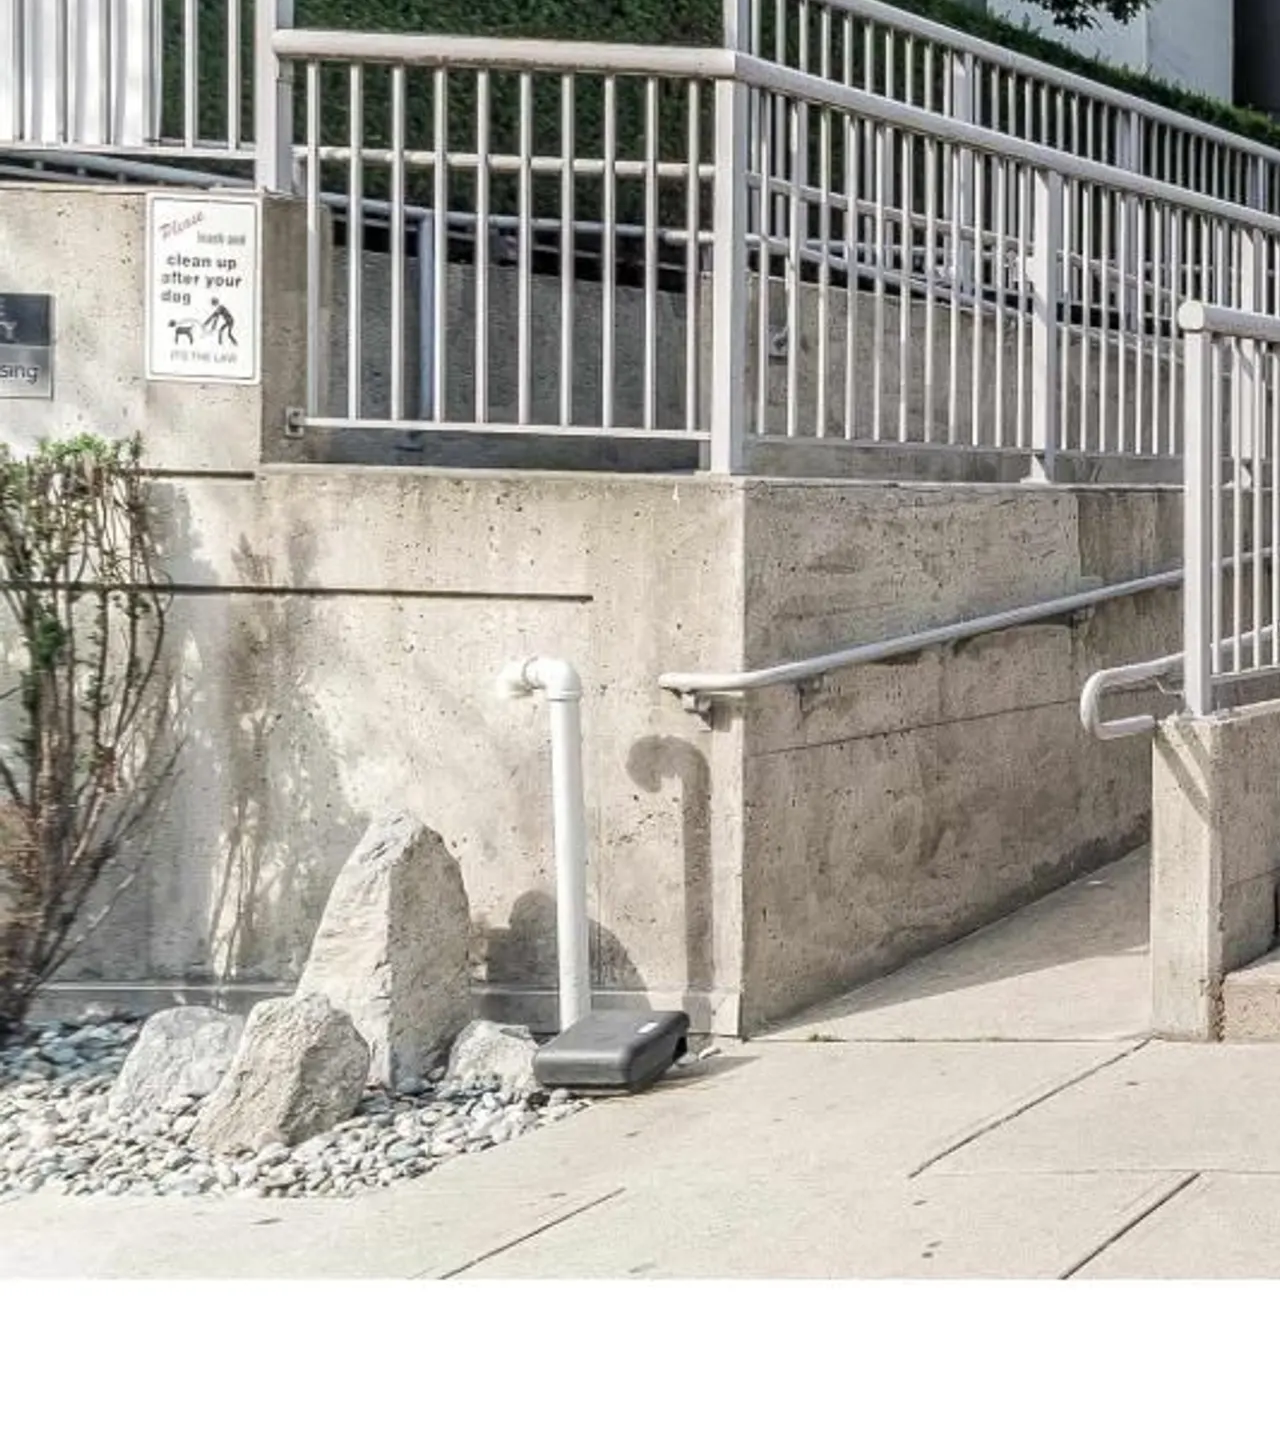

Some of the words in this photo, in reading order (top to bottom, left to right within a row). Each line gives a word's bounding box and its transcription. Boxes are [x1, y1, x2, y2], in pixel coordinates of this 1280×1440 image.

[158, 211, 203, 241] Please
[166, 252, 212, 268] clean
[216, 257, 237, 271] up
[161, 271, 200, 286] after
[205, 275, 242, 289] your
[161, 289, 191, 306] dog
